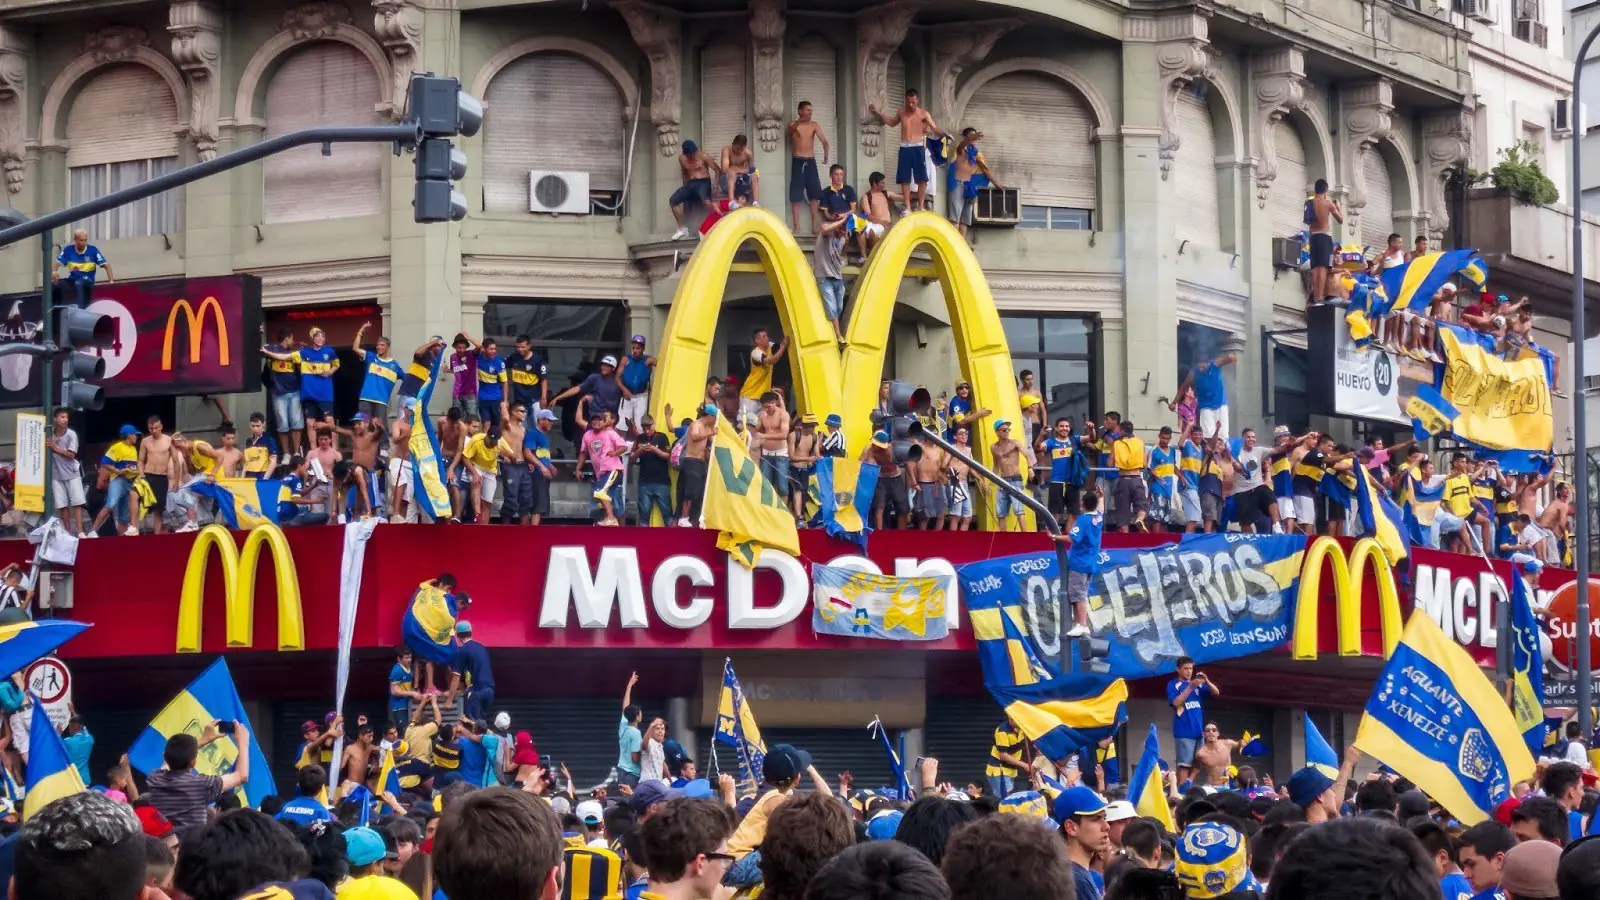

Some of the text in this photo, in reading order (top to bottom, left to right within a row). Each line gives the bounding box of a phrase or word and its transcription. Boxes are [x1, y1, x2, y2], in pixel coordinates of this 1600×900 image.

[1337, 371, 1372, 391] HUEVO
[538, 545, 960, 630] McDn
[1550, 616, 1600, 639] Sut
[1401, 664, 1464, 718] AGUANTE
[1543, 682, 1576, 694] arls
[1387, 699, 1449, 741] XENEIZE
